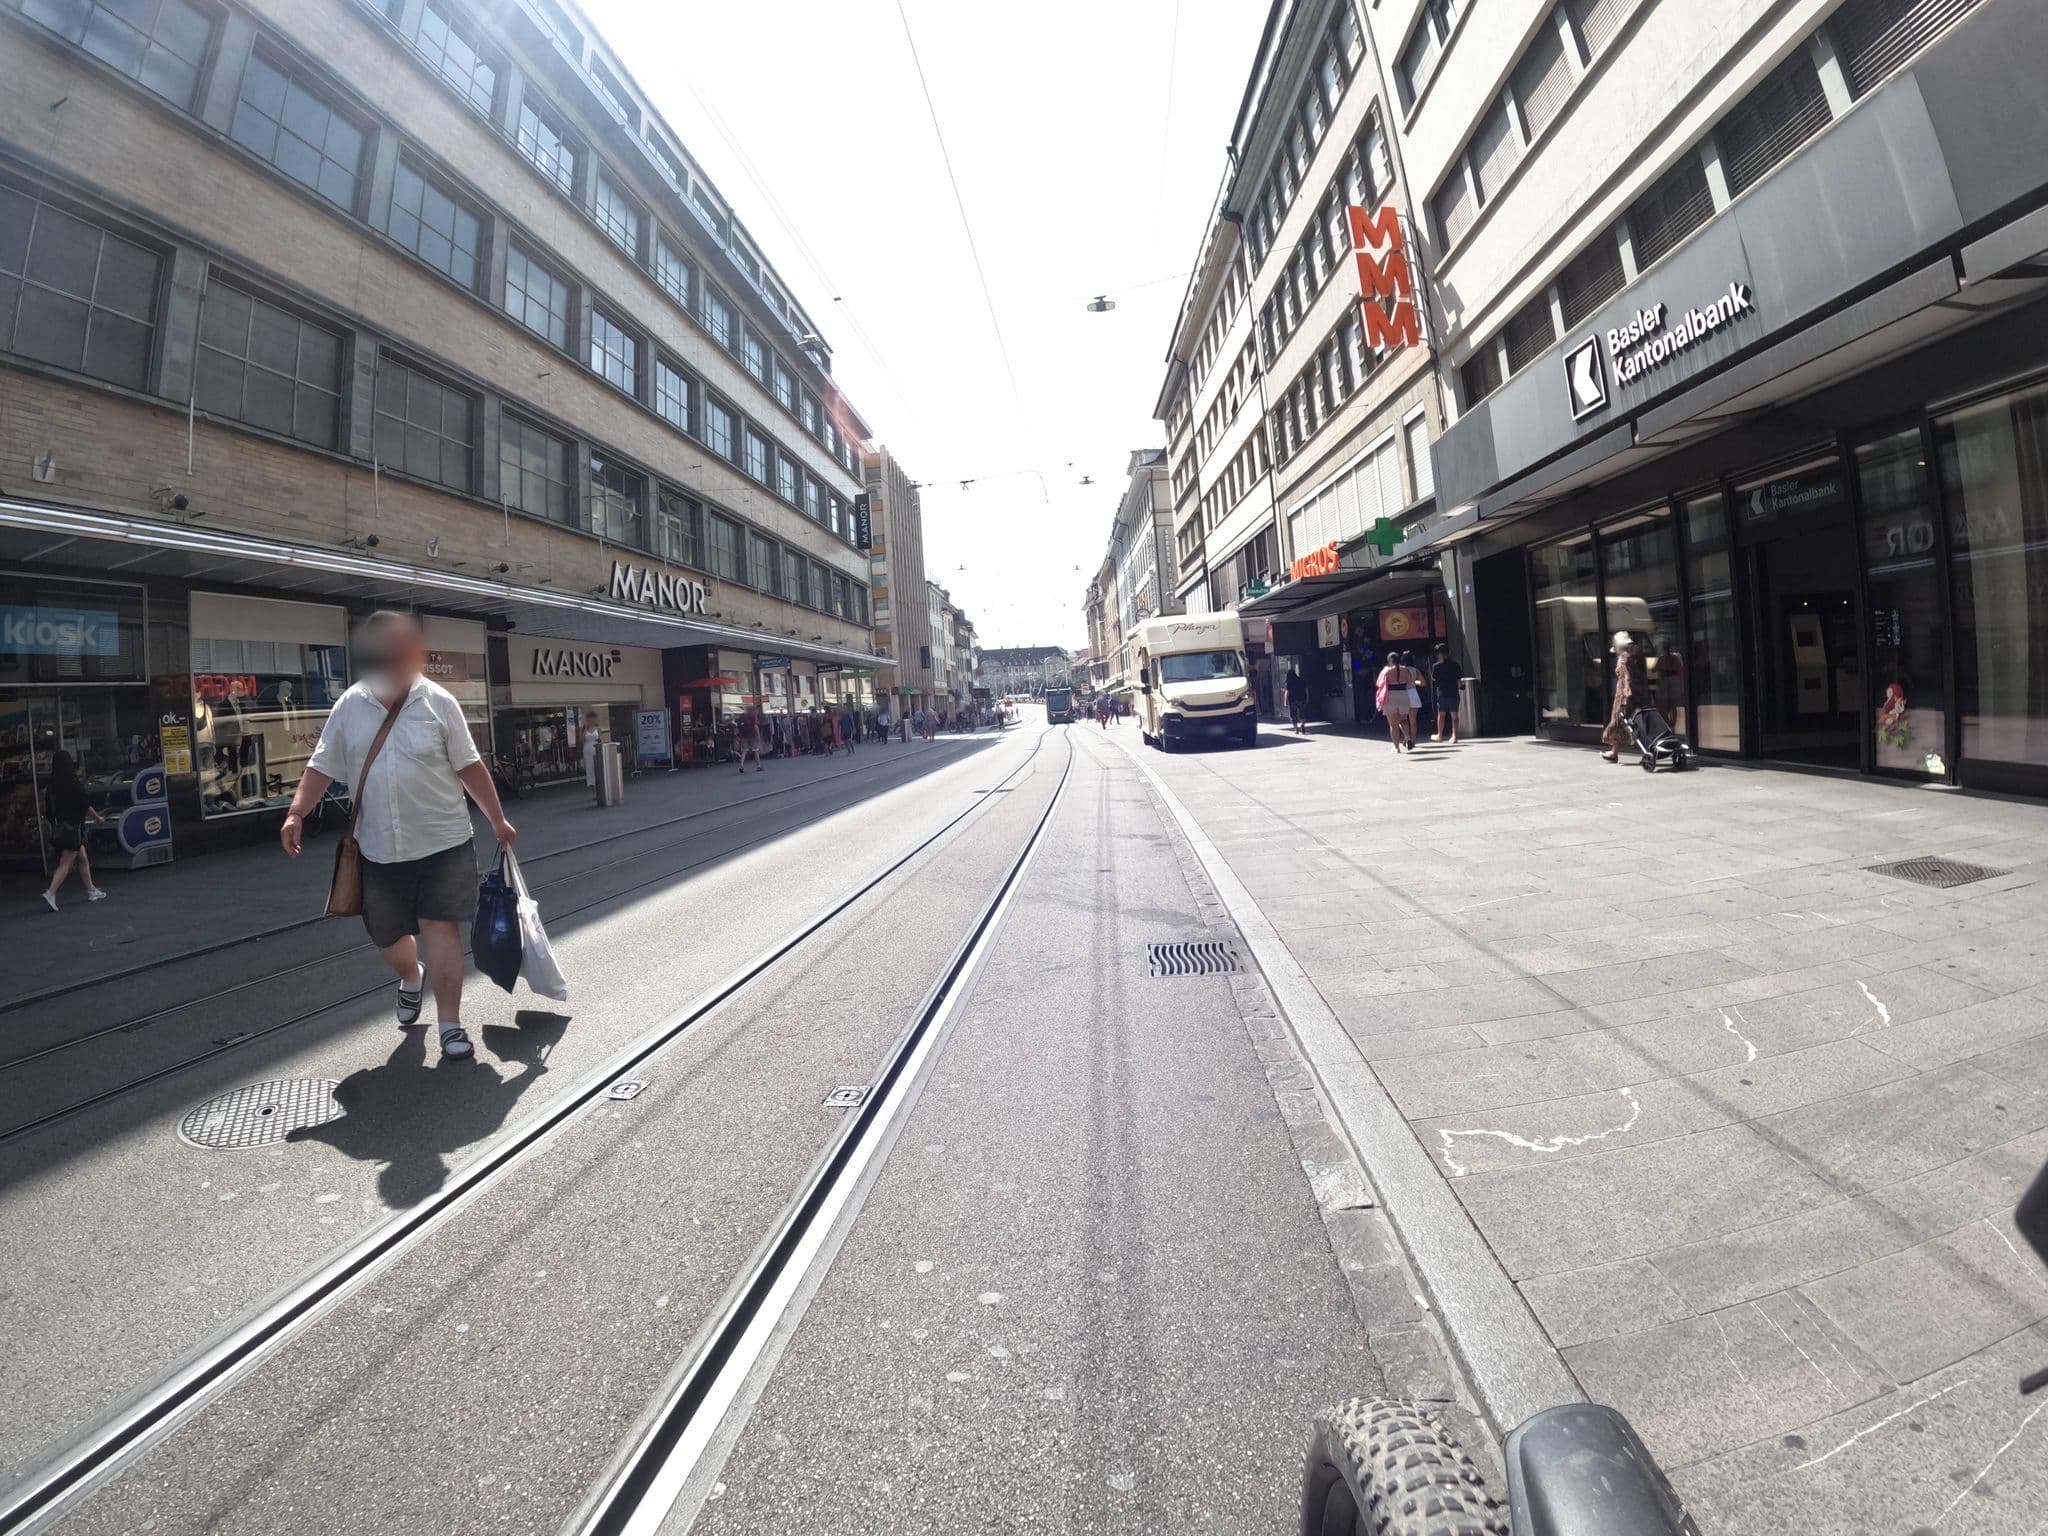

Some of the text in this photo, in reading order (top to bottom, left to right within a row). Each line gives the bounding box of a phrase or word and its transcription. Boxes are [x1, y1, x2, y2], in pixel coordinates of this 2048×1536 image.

[1607, 302, 1664, 356] Basler
[1612, 281, 1750, 386] Kantonalbank
[1770, 480, 1799, 496] Basler
[1772, 482, 1837, 510] Kantonalbank
[1290, 539, 1340, 582] MIGROS
[610, 560, 706, 615] MANOR
[4, 613, 98, 647] kiosk
[533, 649, 614, 678] MANOR
[641, 714, 662, 726] 20%
